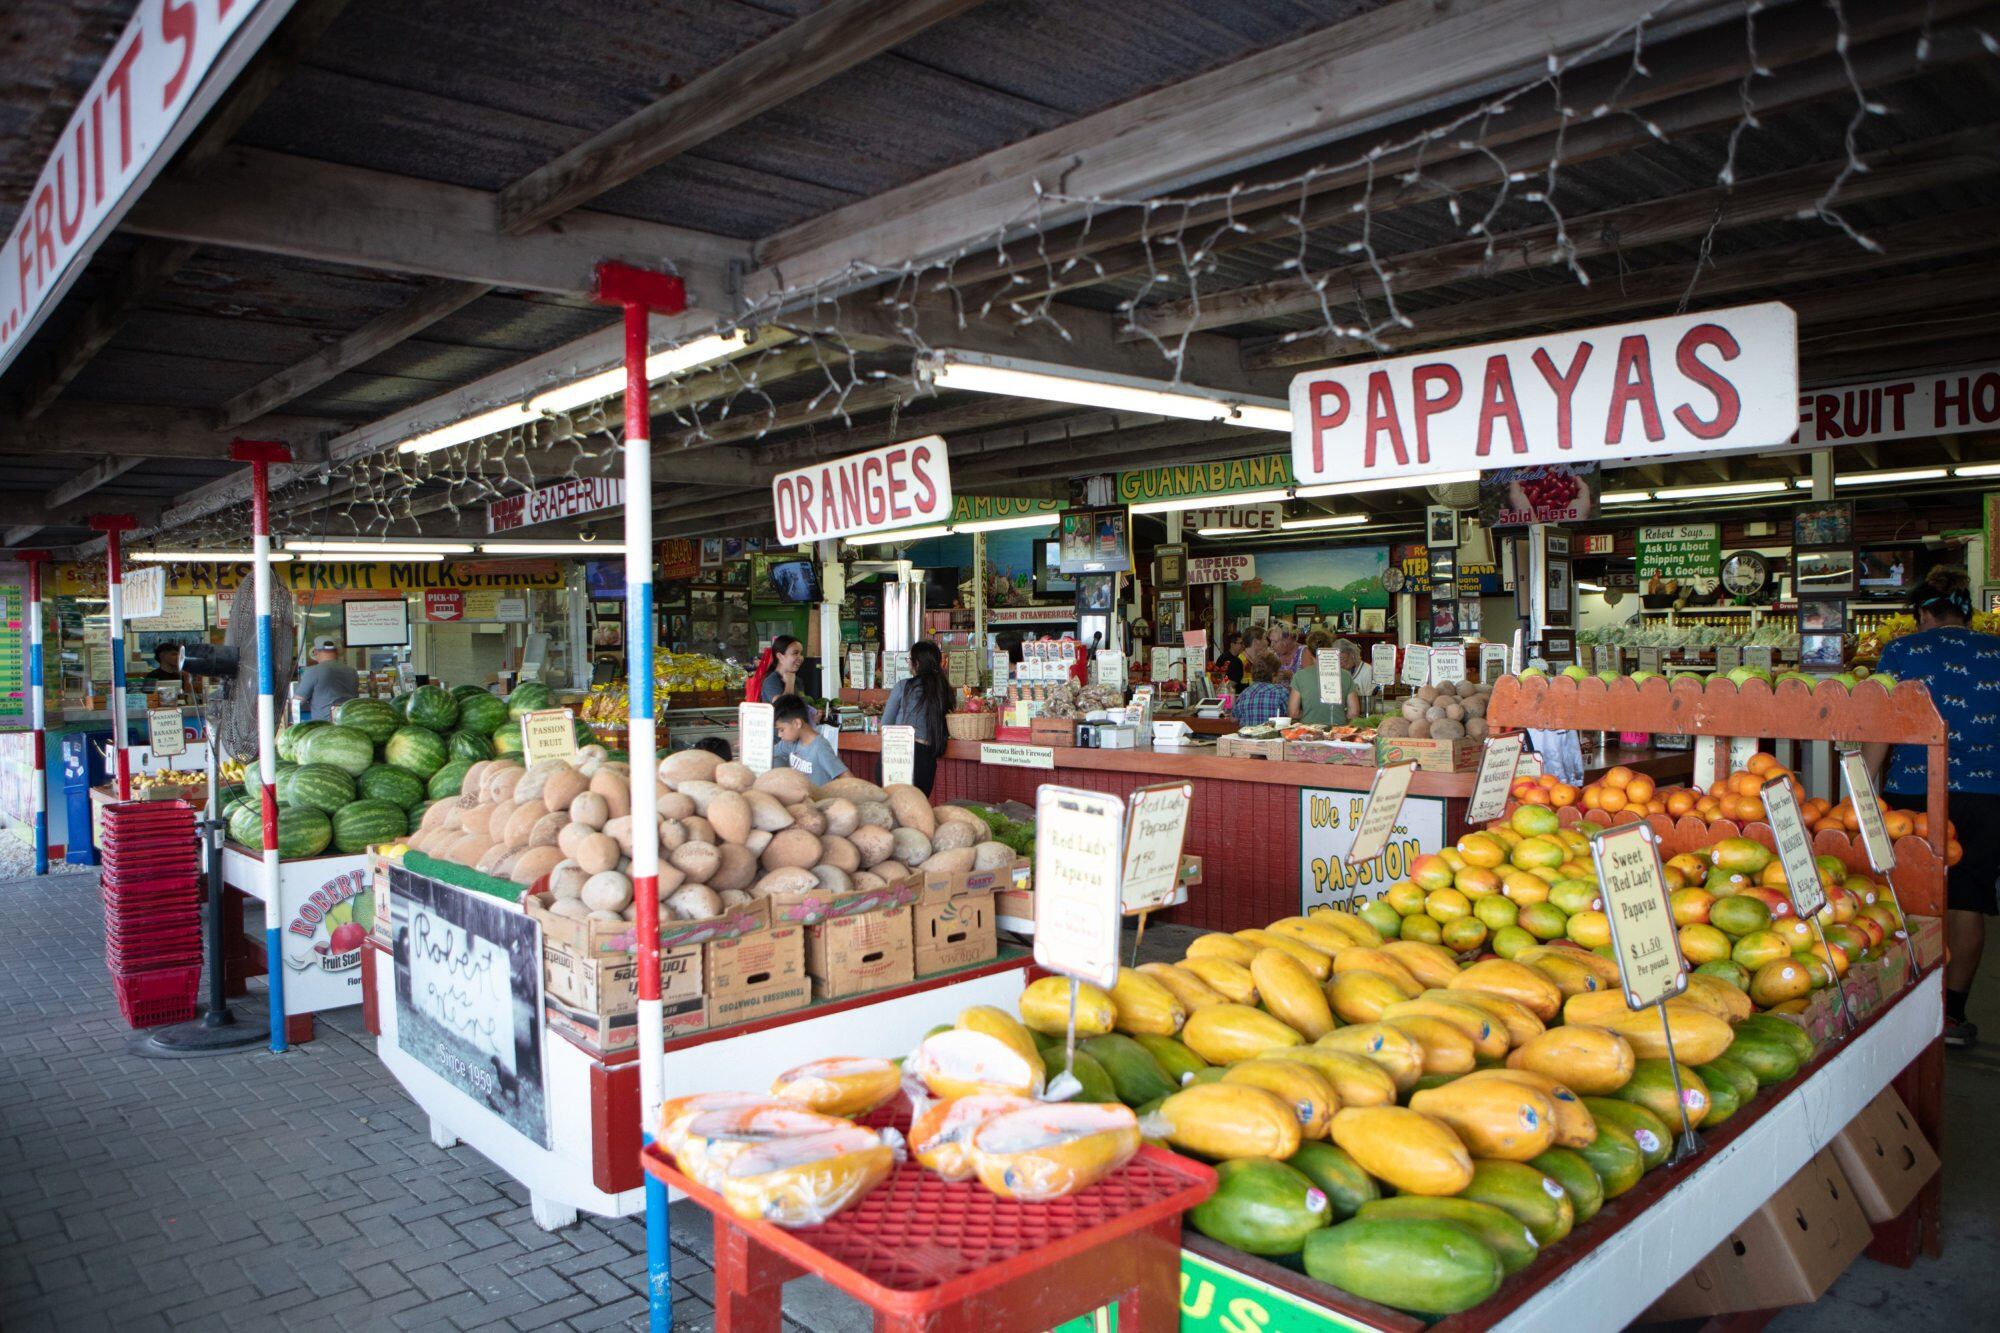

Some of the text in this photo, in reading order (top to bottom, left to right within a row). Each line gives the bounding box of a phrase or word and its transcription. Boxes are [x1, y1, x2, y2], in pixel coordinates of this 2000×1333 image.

[1309, 323, 1741, 474] PAPAYAS
[1791, 383, 1915, 444] FRUIT
[1121, 453, 1287, 499] GUANABANA
[778, 445, 938, 540] ORANGES
[1183, 510, 1275, 529] ETTUCE
[1500, 506, 1578, 524] Sold Here
[1645, 526, 1712, 540] Robert Says...
[1645, 541, 1709, 553] Ask Us About
[1194, 555, 1249, 569] RIPENED
[1643, 553, 1711, 566] Shipping Your
[290, 561, 377, 590] FRUIT
[1665, 567, 1673, 576] &
[428, 593, 460, 602] PICK-UP
[1020, 609, 1074, 620] STRAWBERRIES
[533, 724, 566, 735] PASSION
[539, 738, 563, 748] FRUIT
[982, 746, 1052, 758] Minnesota Birch Firewood
[1311, 794, 1340, 829] We
[1311, 838, 1421, 893] PASSION
[1611, 847, 1644, 870] Sweet
[1053, 858, 1102, 887] Papayas
[1607, 863, 1656, 894] "Red Lady"
[1621, 897, 1657, 923] Papayas
[322, 950, 361, 970] Fruit Stan
[414, 911, 500, 994] Robert
[1637, 955, 1670, 977] Per pound
[717, 987, 805, 1014] TENNESSEE TOMATOES
[438, 1042, 493, 1096] Since 1959
